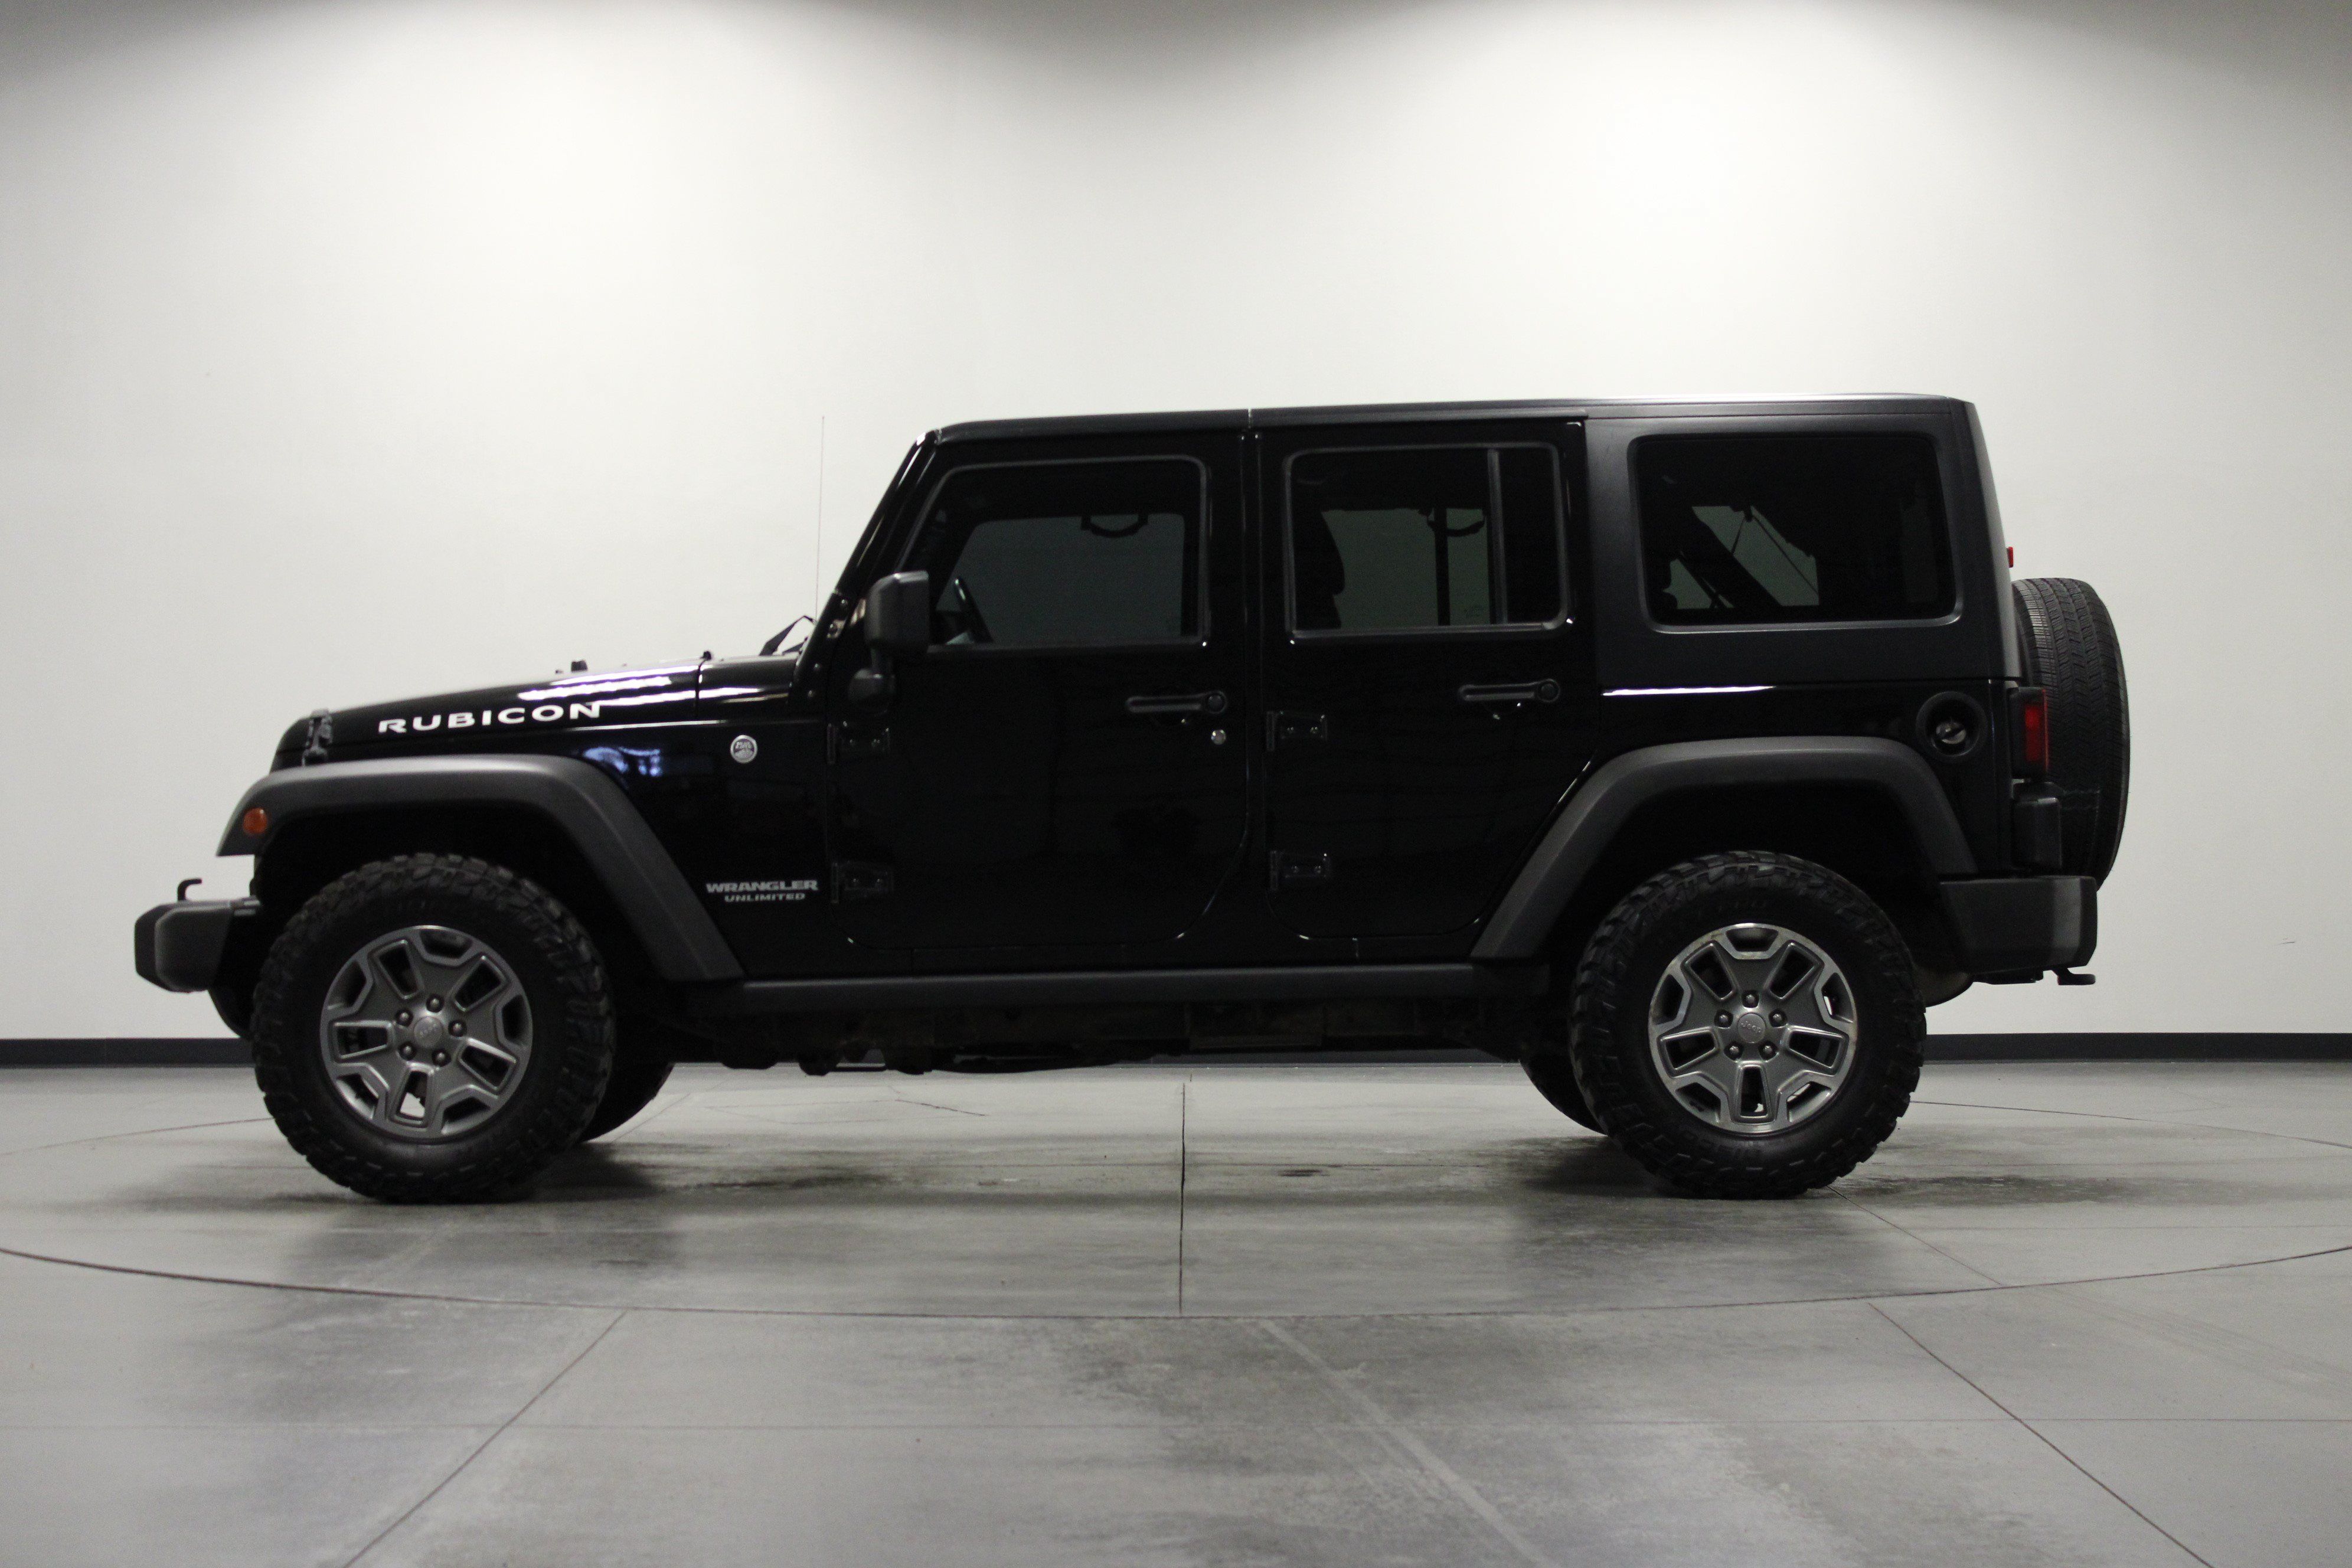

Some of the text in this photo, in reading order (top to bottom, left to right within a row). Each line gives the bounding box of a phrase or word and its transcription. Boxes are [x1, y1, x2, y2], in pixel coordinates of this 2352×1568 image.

[378, 703, 600, 734] RUBICON
[706, 880, 818, 893] WRANGLER
[724, 893, 805, 902] UNLIMITED
